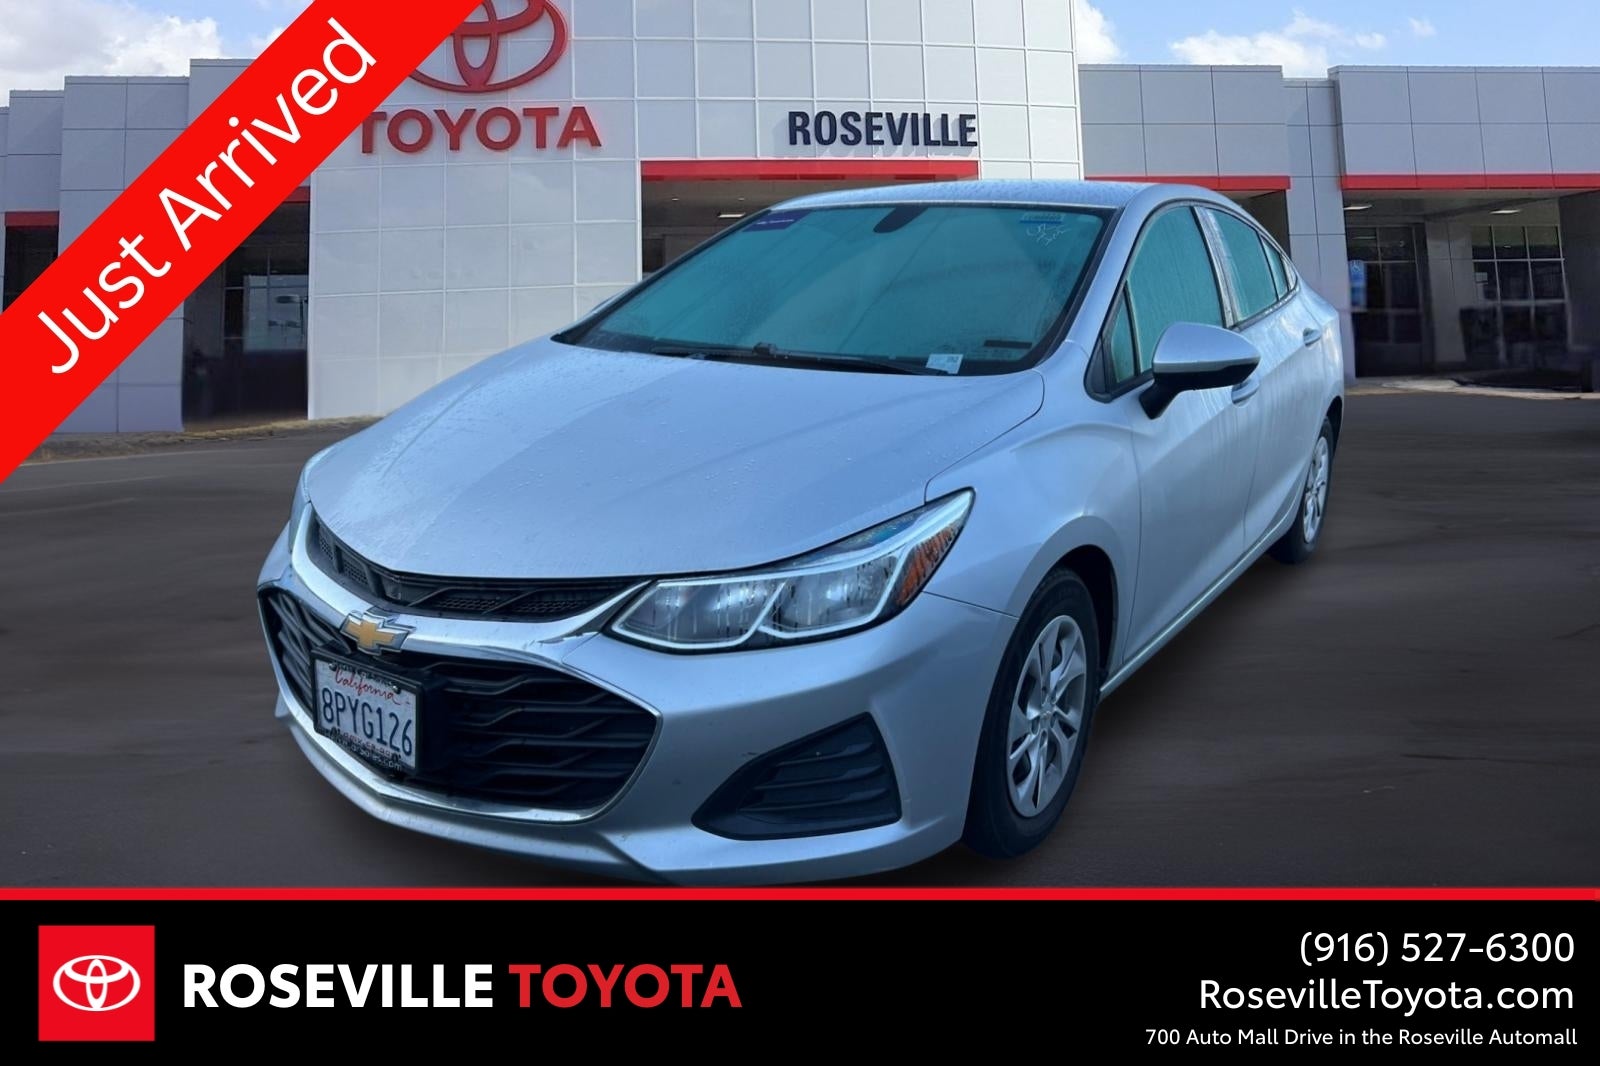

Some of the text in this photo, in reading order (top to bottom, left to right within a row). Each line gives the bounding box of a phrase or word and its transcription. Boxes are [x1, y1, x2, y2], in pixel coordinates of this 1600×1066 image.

[361, 107, 602, 153] TOYOTA
[788, 111, 977, 147] ROSEVILLE
[333, 666, 400, 705] California
[322, 687, 413, 757] 8PYG126
